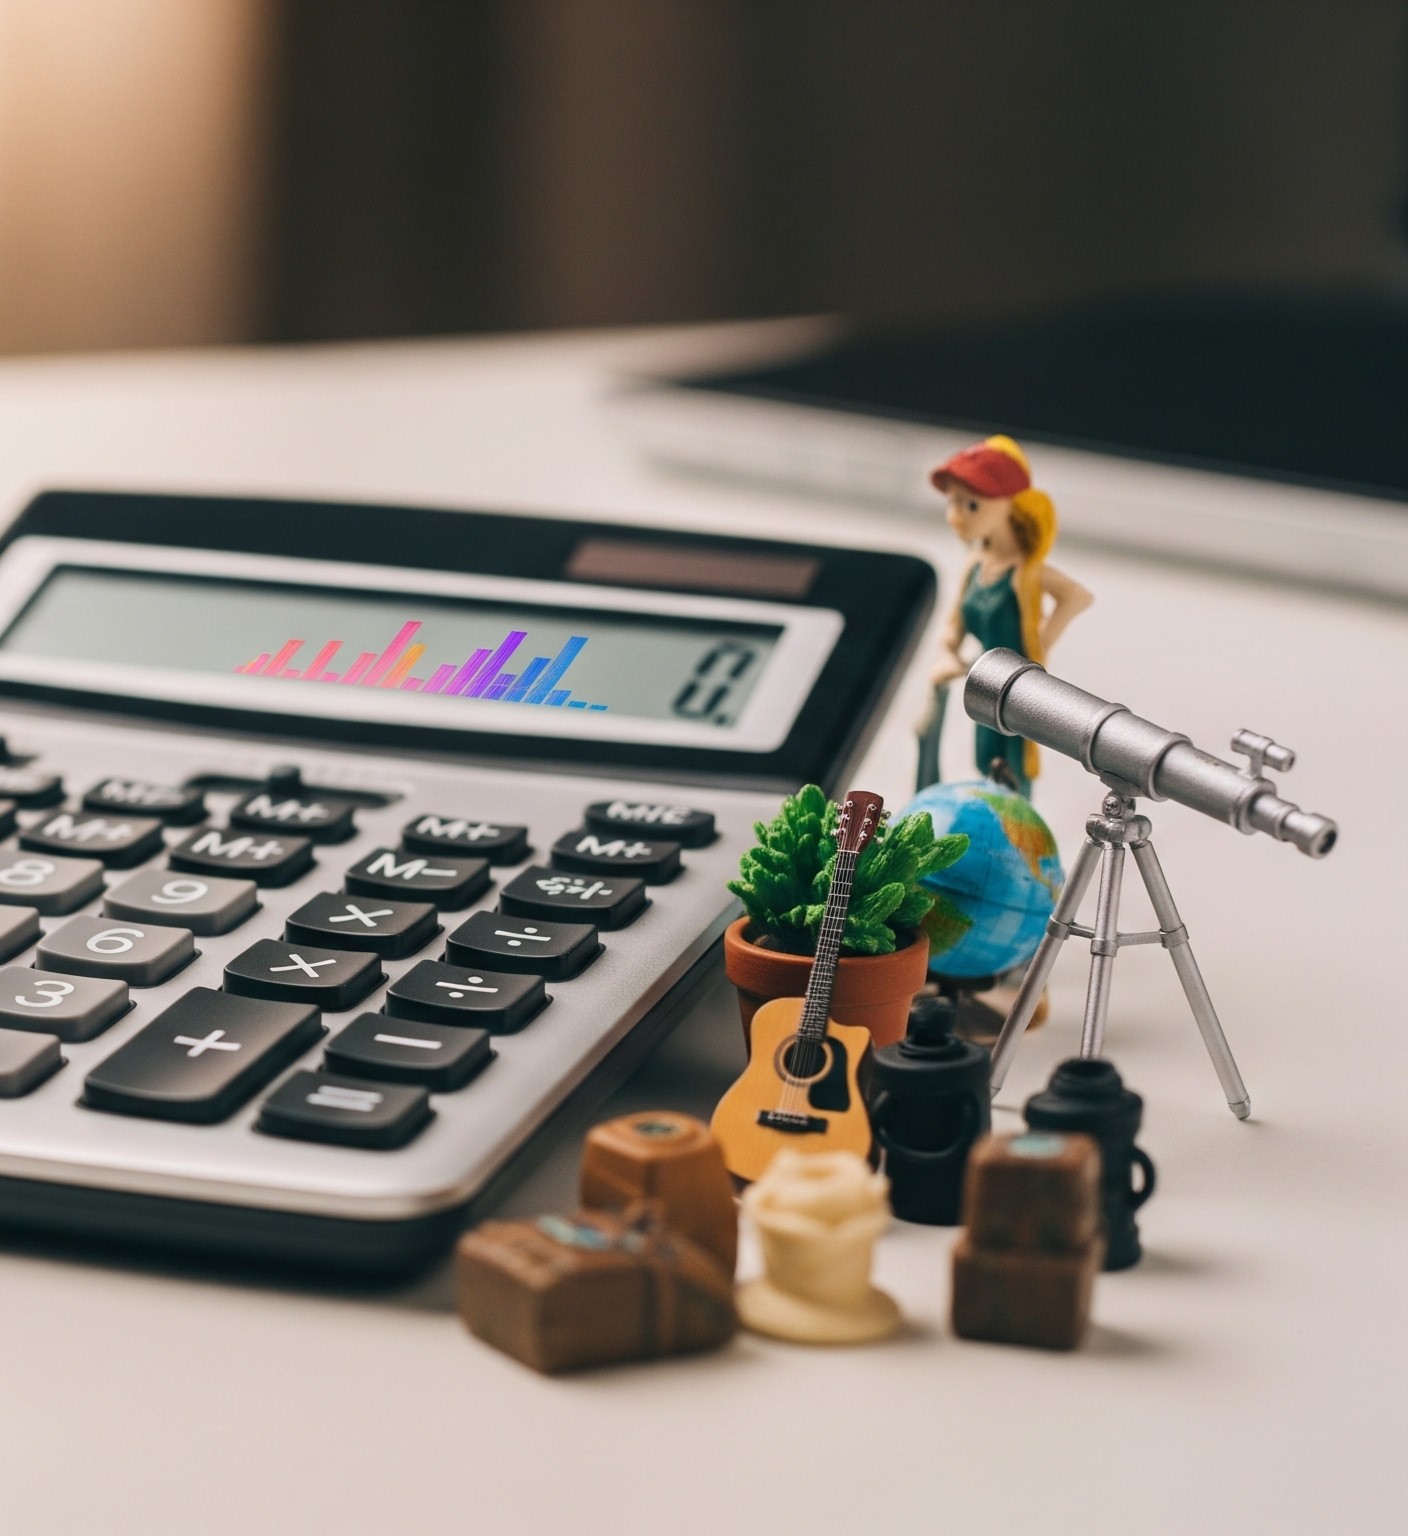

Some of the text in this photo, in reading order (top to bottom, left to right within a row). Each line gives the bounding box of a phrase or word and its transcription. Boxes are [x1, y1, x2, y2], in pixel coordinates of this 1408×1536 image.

[416, 815, 500, 841] M+
[191, 831, 285, 861] M+
[575, 835, 652, 859] M+
[149, 879, 209, 905] 9
[85, 928, 144, 955] 6
[13, 979, 76, 1008] 3
[172, 1028, 242, 1058] +
[306, 1084, 384, 1112] =
